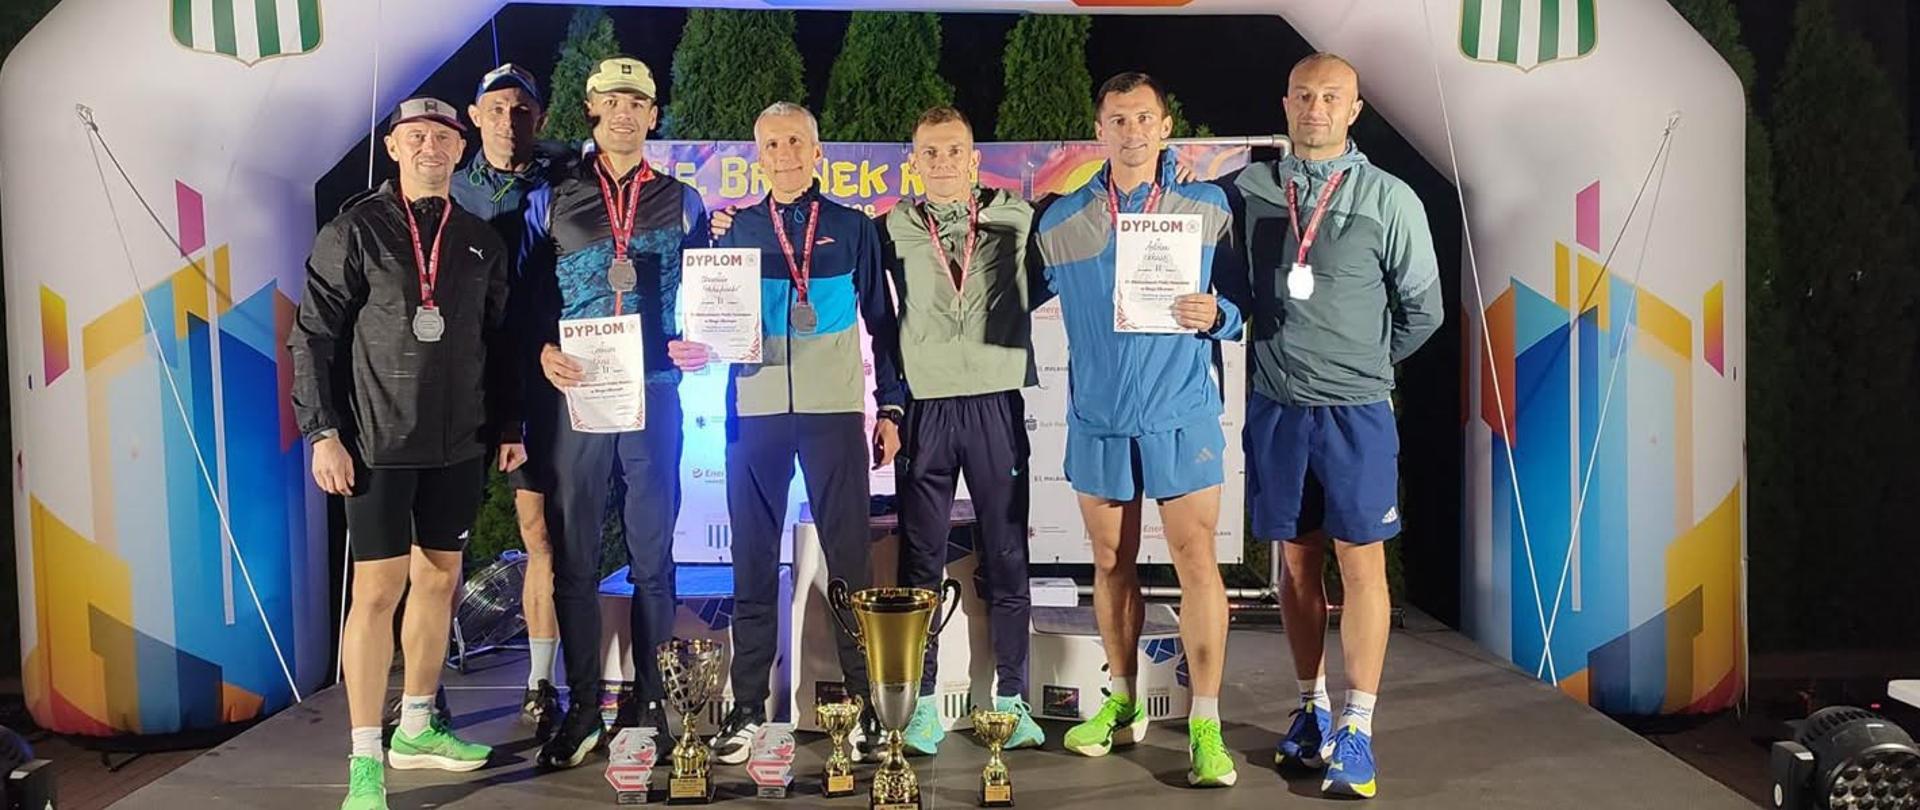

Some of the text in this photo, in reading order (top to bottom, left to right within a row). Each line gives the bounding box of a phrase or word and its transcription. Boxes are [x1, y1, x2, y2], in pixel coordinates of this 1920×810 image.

[719, 156, 889, 198] BRNEK
[1121, 219, 1183, 233] DYPLOM
[686, 254, 742, 267] DYPLOM
[563, 322, 625, 338] DYPLOM
